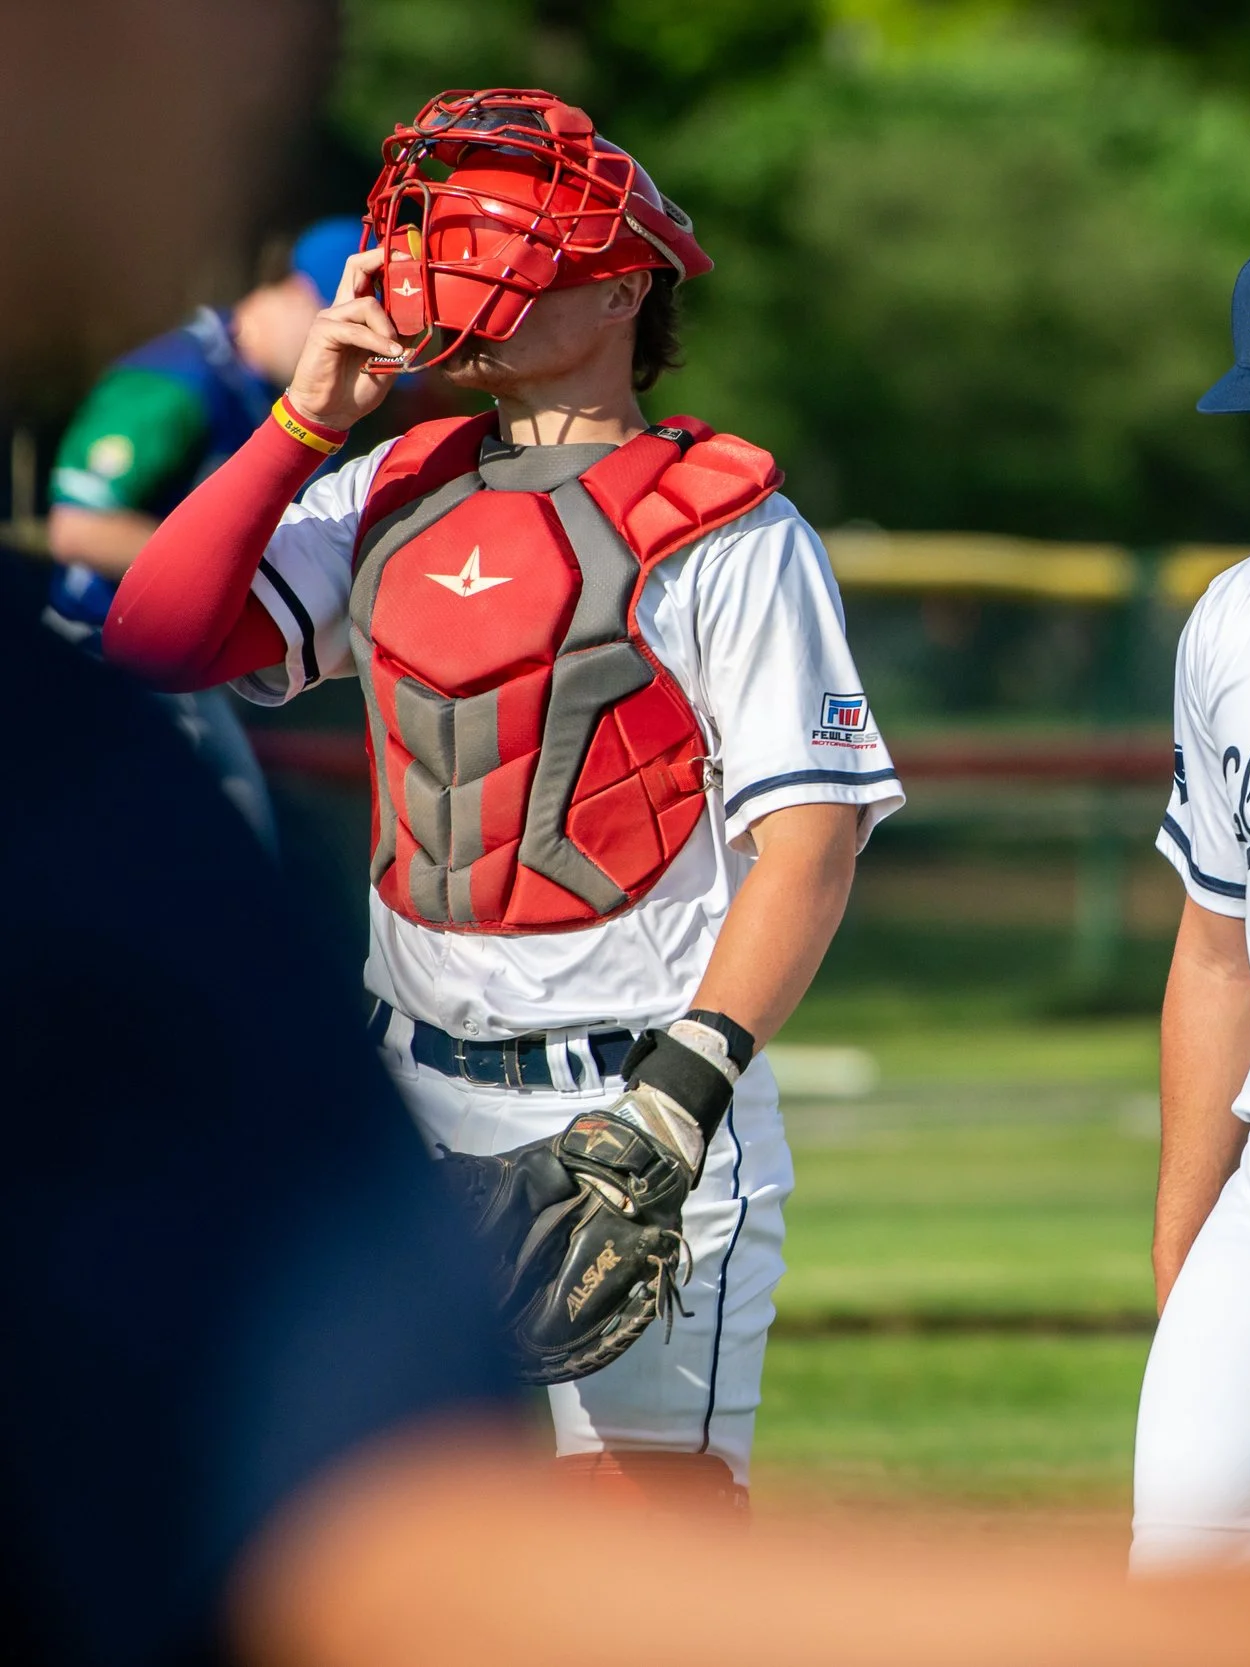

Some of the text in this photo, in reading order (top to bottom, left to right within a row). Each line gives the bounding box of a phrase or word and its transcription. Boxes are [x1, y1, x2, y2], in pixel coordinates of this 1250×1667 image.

[285, 420, 307, 440] B#4
[811, 740, 878, 750] MOTORSPORTS
[812, 730, 879, 744] FEWLESS
[566, 1246, 622, 1323] ALL-STAR
